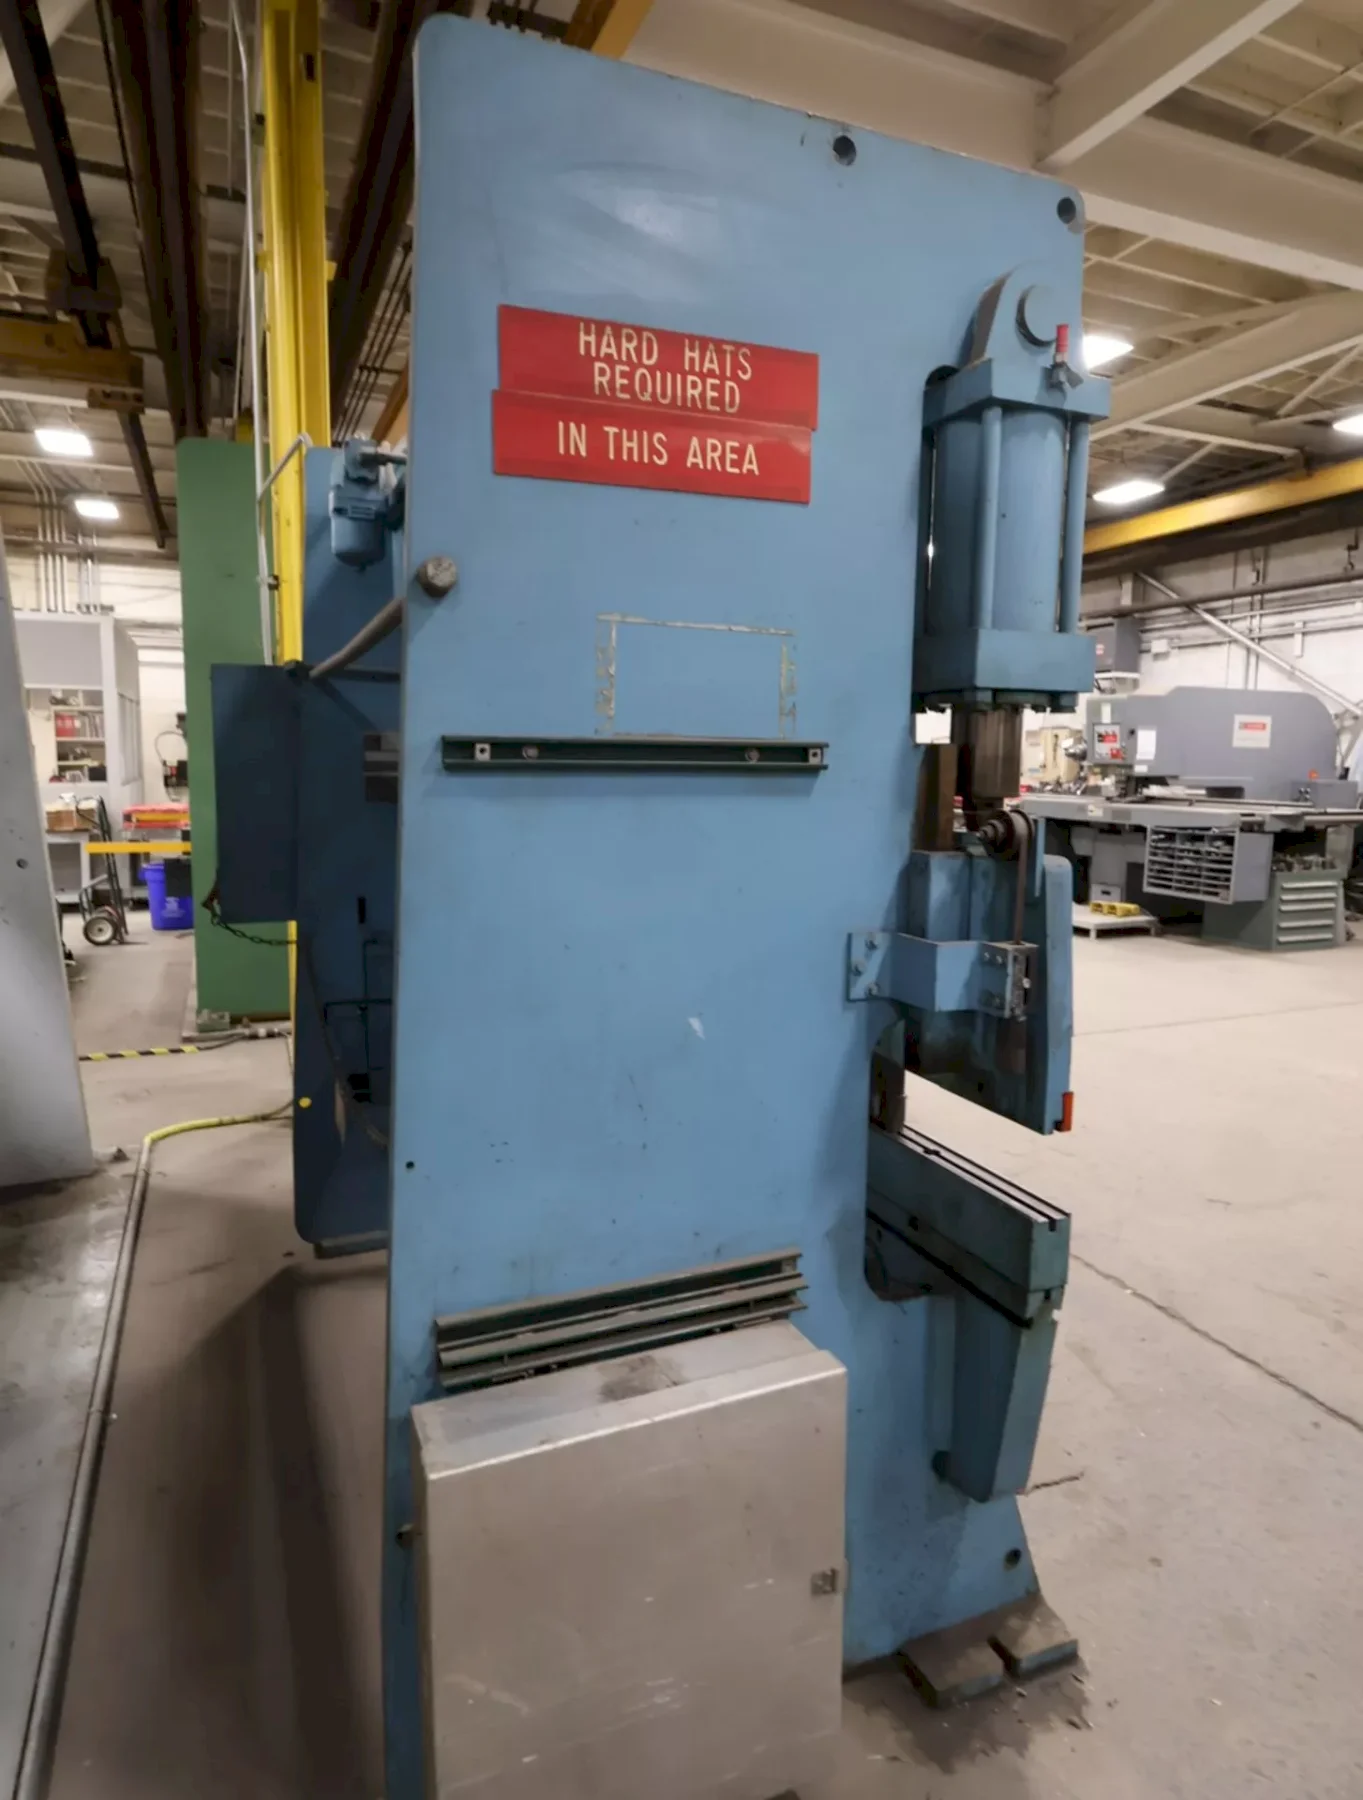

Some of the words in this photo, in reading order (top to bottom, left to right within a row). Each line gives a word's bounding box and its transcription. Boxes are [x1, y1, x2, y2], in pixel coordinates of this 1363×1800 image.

[578, 321, 659, 366] HARD
[683, 338, 753, 381] HATS
[593, 360, 741, 414] REQUIRED
[558, 420, 587, 458] IN
[602, 425, 669, 466] THIS
[685, 435, 760, 476] AREA
